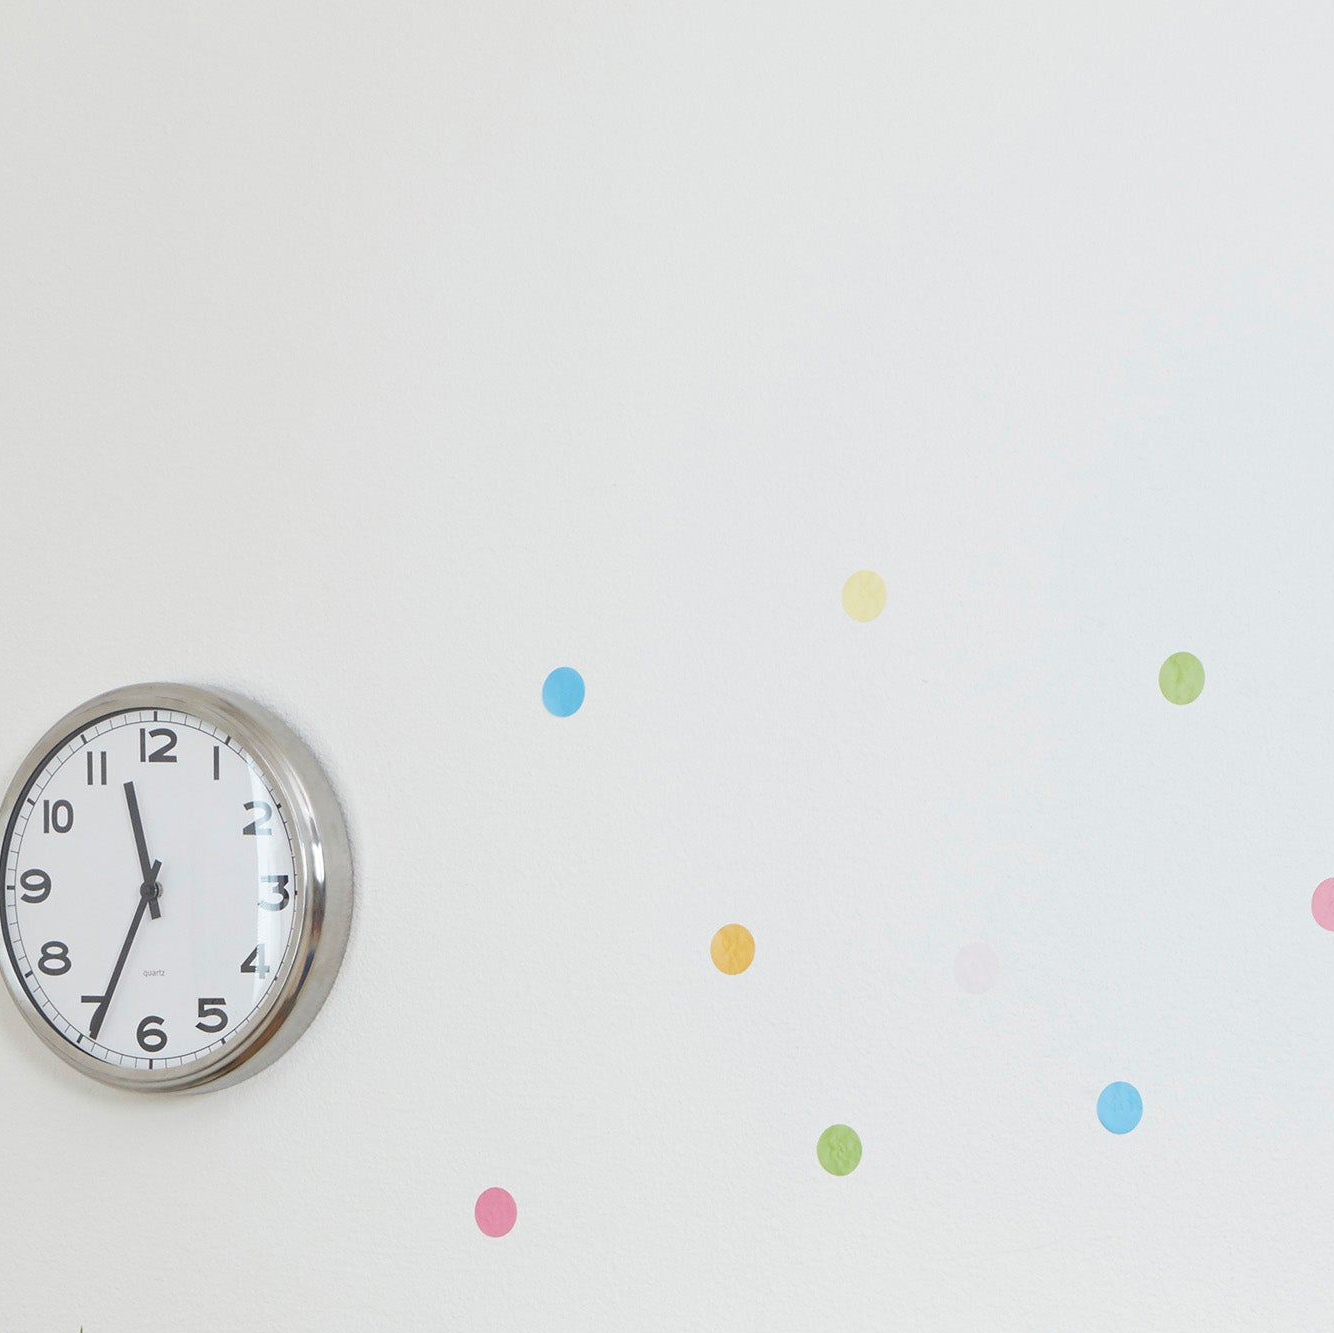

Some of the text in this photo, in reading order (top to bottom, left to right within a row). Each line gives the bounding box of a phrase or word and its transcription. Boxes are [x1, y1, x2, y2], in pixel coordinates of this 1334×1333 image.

[139, 727, 178, 763] 12
[213, 745, 220, 781] 1
[87, 751, 108, 786] 11
[43, 799, 74, 834] 10
[243, 801, 273, 836] 2
[19, 868, 52, 904] 9
[257, 874, 290, 912] 3
[37, 940, 72, 976] 8
[142, 967, 166, 978] quartz
[240, 943, 271, 980] 4
[195, 997, 229, 1033] 5
[136, 1015, 168, 1053] 6
